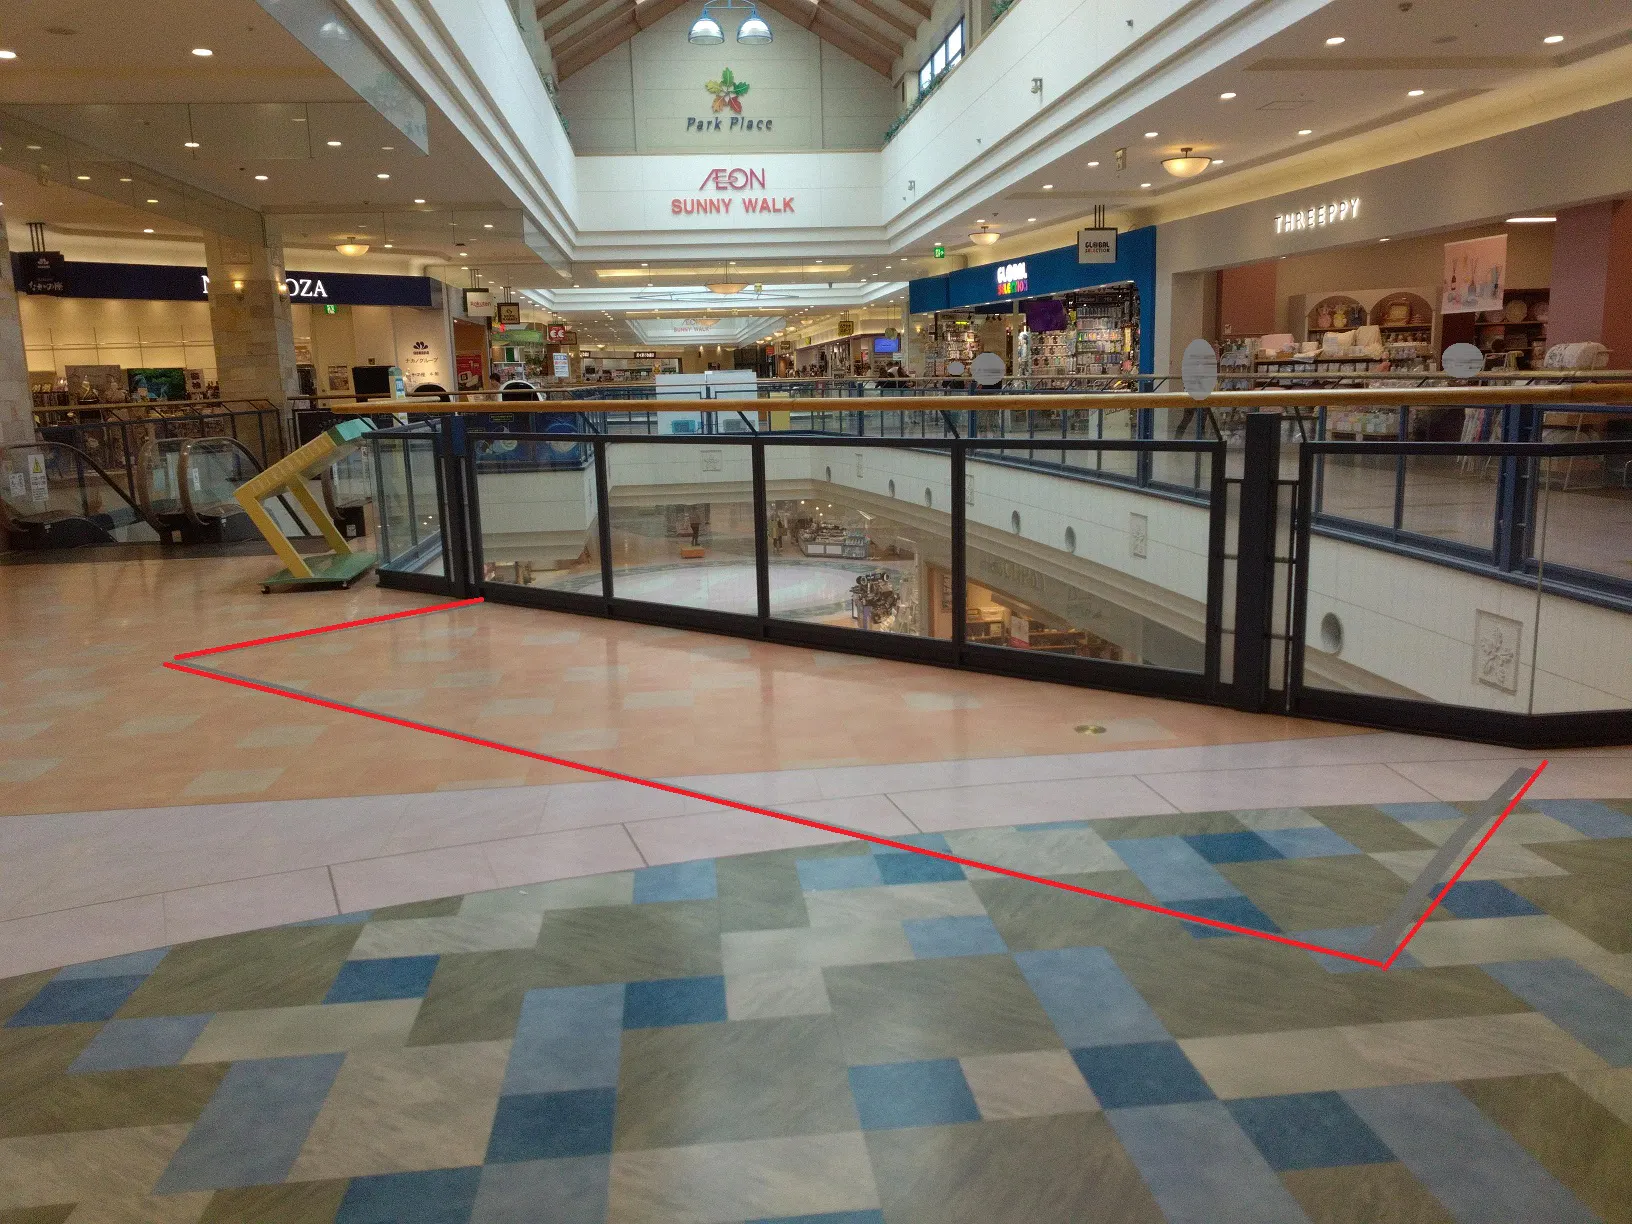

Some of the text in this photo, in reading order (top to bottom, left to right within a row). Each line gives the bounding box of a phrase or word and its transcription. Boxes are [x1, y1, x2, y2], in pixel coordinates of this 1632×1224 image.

[686, 116, 774, 132] Park Place
[671, 196, 795, 215] SUNNY WALK
[1273, 197, 1360, 234] THREEPPY
